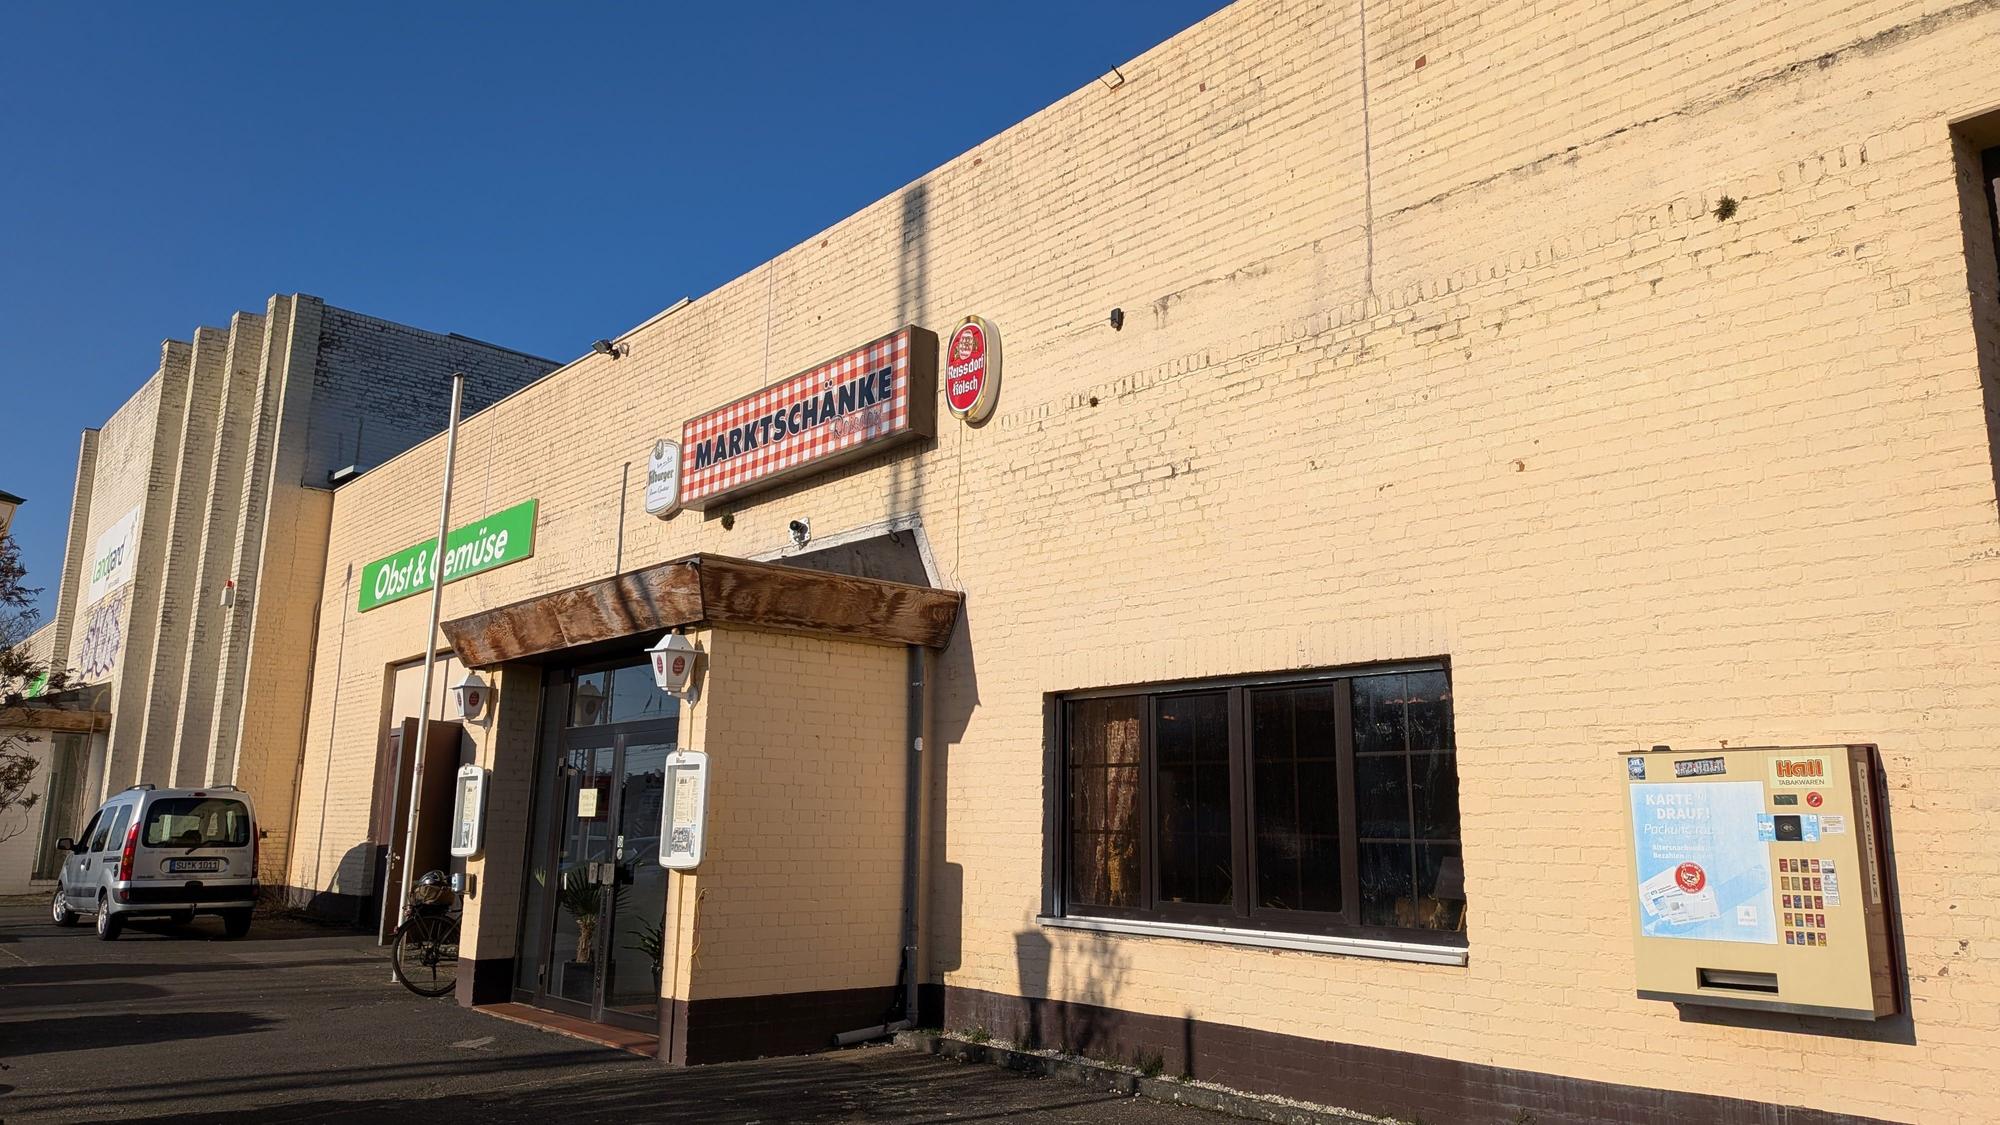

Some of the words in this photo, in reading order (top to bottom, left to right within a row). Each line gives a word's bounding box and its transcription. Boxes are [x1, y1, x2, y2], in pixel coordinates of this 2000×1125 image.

[948, 353, 984, 379] Reissdorf
[953, 375, 978, 396] Kölsch
[695, 366, 892, 471] MARKTSCHÄNKE
[375, 557, 415, 600] Obst
[413, 550, 427, 587] &
[1776, 759, 1823, 777] Hall
[1646, 793, 1693, 806] KARTE
[1656, 807, 1711, 820] DRAUF!
[1860, 768, 1878, 898] CIGARETTEN
[198, 860, 218, 869] 1011
